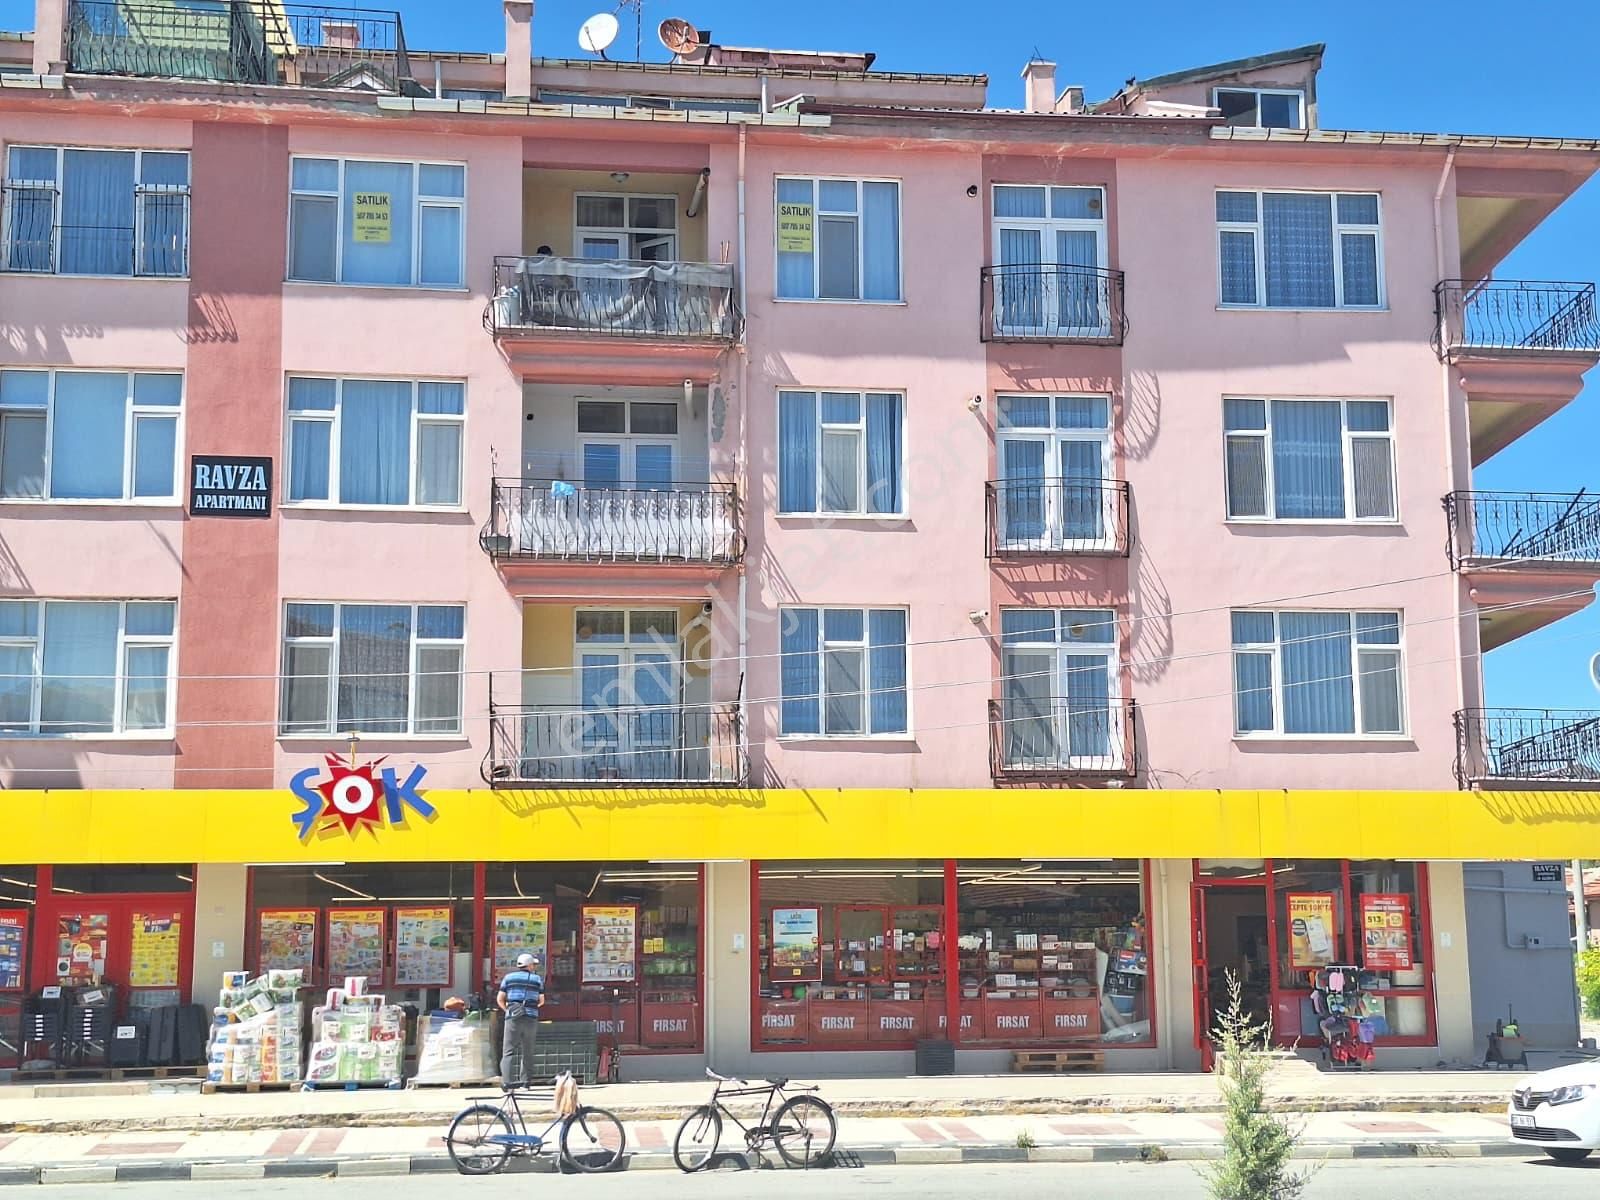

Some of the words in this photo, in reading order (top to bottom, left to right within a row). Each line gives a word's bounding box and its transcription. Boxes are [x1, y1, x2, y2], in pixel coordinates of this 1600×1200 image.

[357, 195, 388, 205] SATILIK
[781, 206, 811, 216] SATILIK
[195, 464, 267, 490] RAVZA
[195, 495, 266, 510] APARTMANI
[290, 763, 436, 840] ŞOK
[653, 1019, 688, 1032] FIRSAT
[762, 1014, 796, 1028] FIRSAT
[821, 1016, 855, 1029] FIRSAT
[880, 1016, 914, 1029] FIRSAT
[939, 1015, 972, 1028] FIAT
[997, 1015, 1030, 1028] FIRSAT
[1055, 1014, 1087, 1027] FIRSAT
